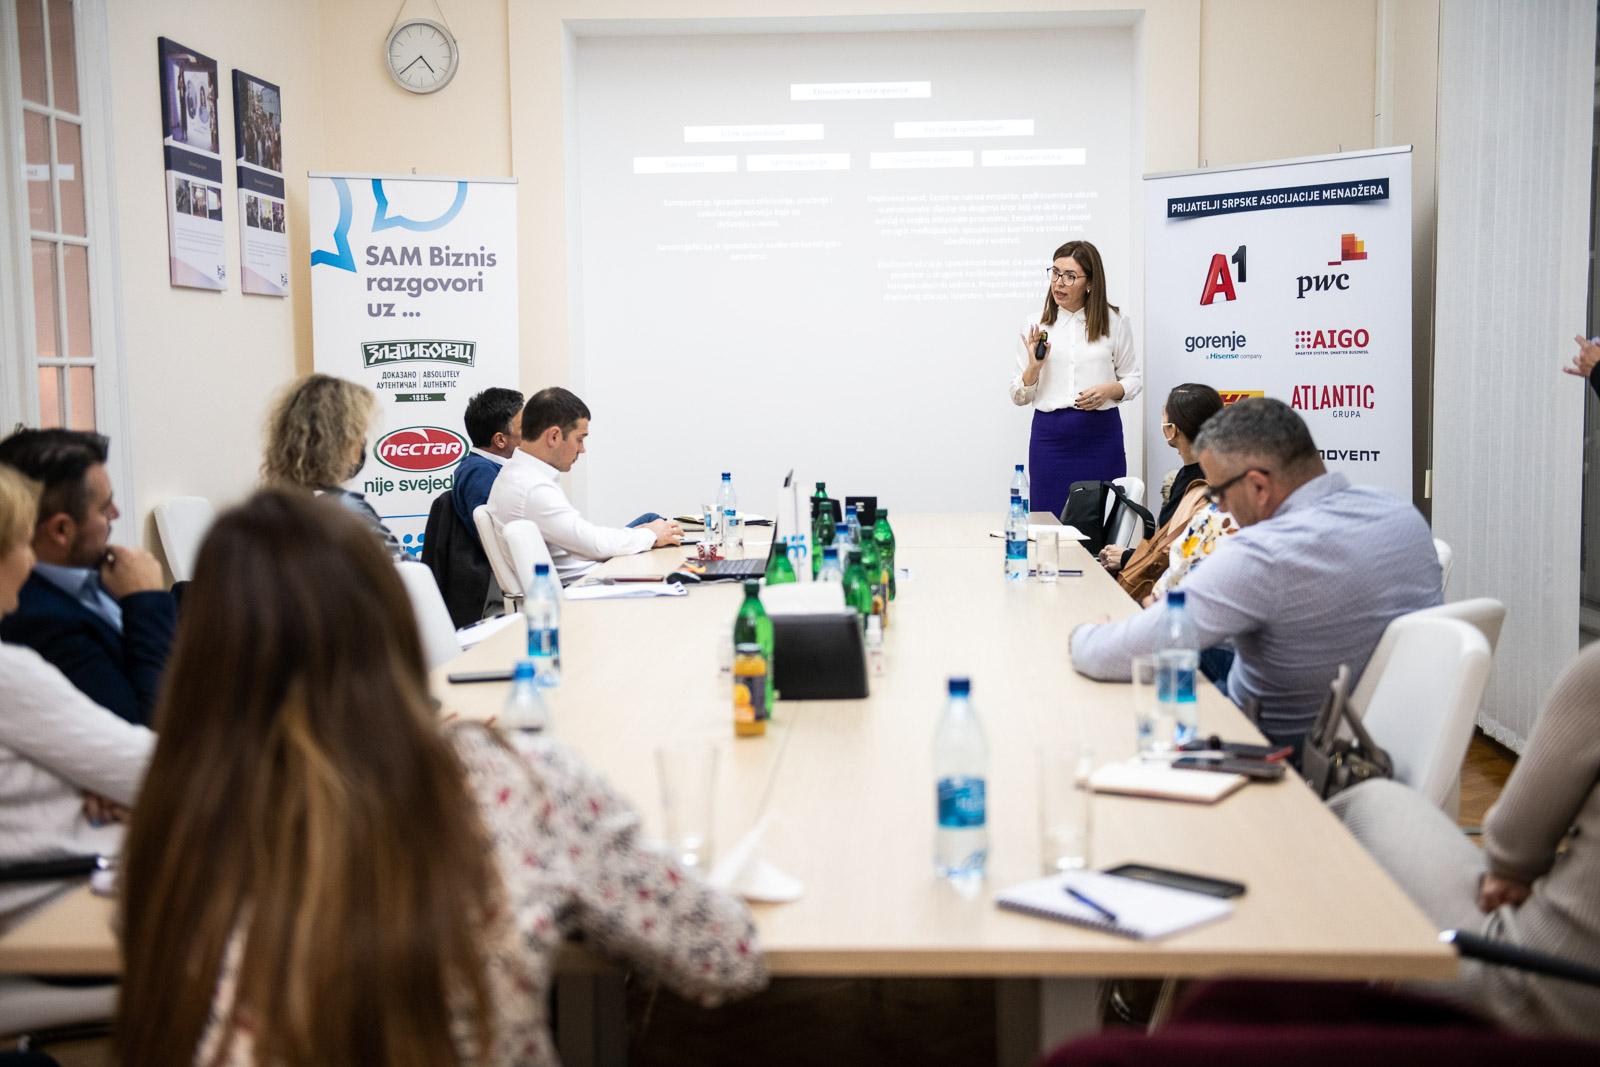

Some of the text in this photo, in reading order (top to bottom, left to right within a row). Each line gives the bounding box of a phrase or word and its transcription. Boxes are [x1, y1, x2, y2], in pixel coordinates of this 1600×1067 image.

[1171, 184, 1384, 213] PRIJATELJI SRPSKE ASOCIJACIJE MENADŽERA
[366, 245, 496, 267] SAM Biznis
[367, 272, 483, 297] razgovori
[1200, 245, 1247, 305] A1
[1296, 273, 1349, 298] pwc
[368, 303, 396, 317] uz
[1185, 331, 1246, 352] gorenje
[1313, 329, 1369, 348] AIGO
[1292, 385, 1374, 410] ATLANTIC
[365, 475, 454, 496] nije svejed
